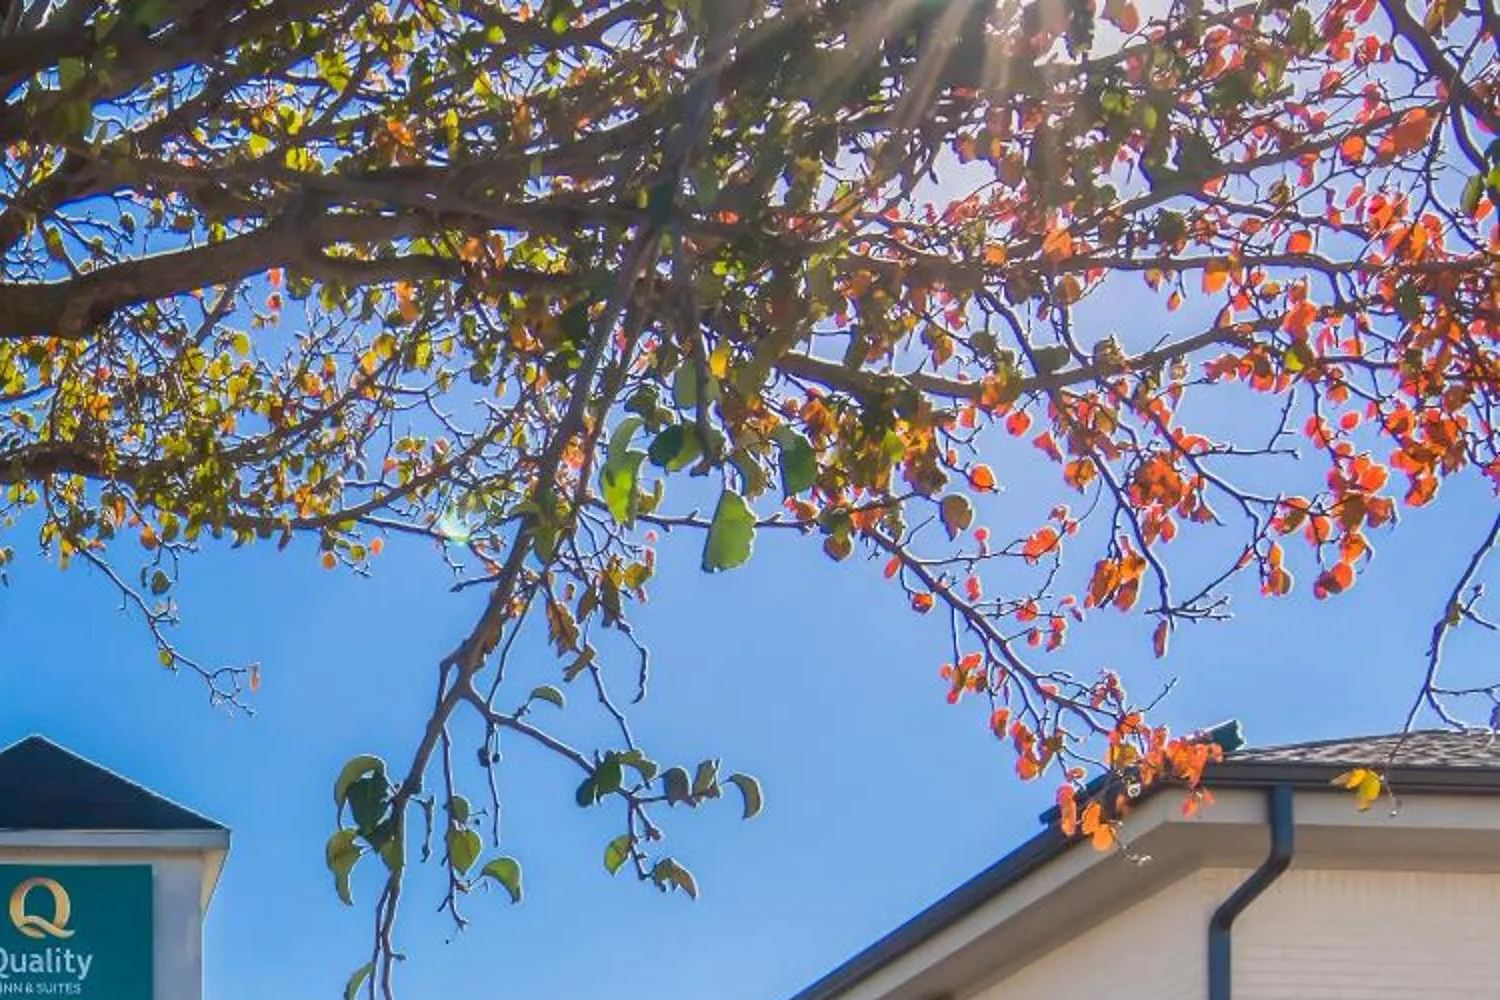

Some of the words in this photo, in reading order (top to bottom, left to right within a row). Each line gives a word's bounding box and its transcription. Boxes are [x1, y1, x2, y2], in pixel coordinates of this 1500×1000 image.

[9, 876, 76, 939] Q
[0, 982, 23, 995] INN
[25, 982, 34, 995] &
[35, 982, 82, 995] SUITES
